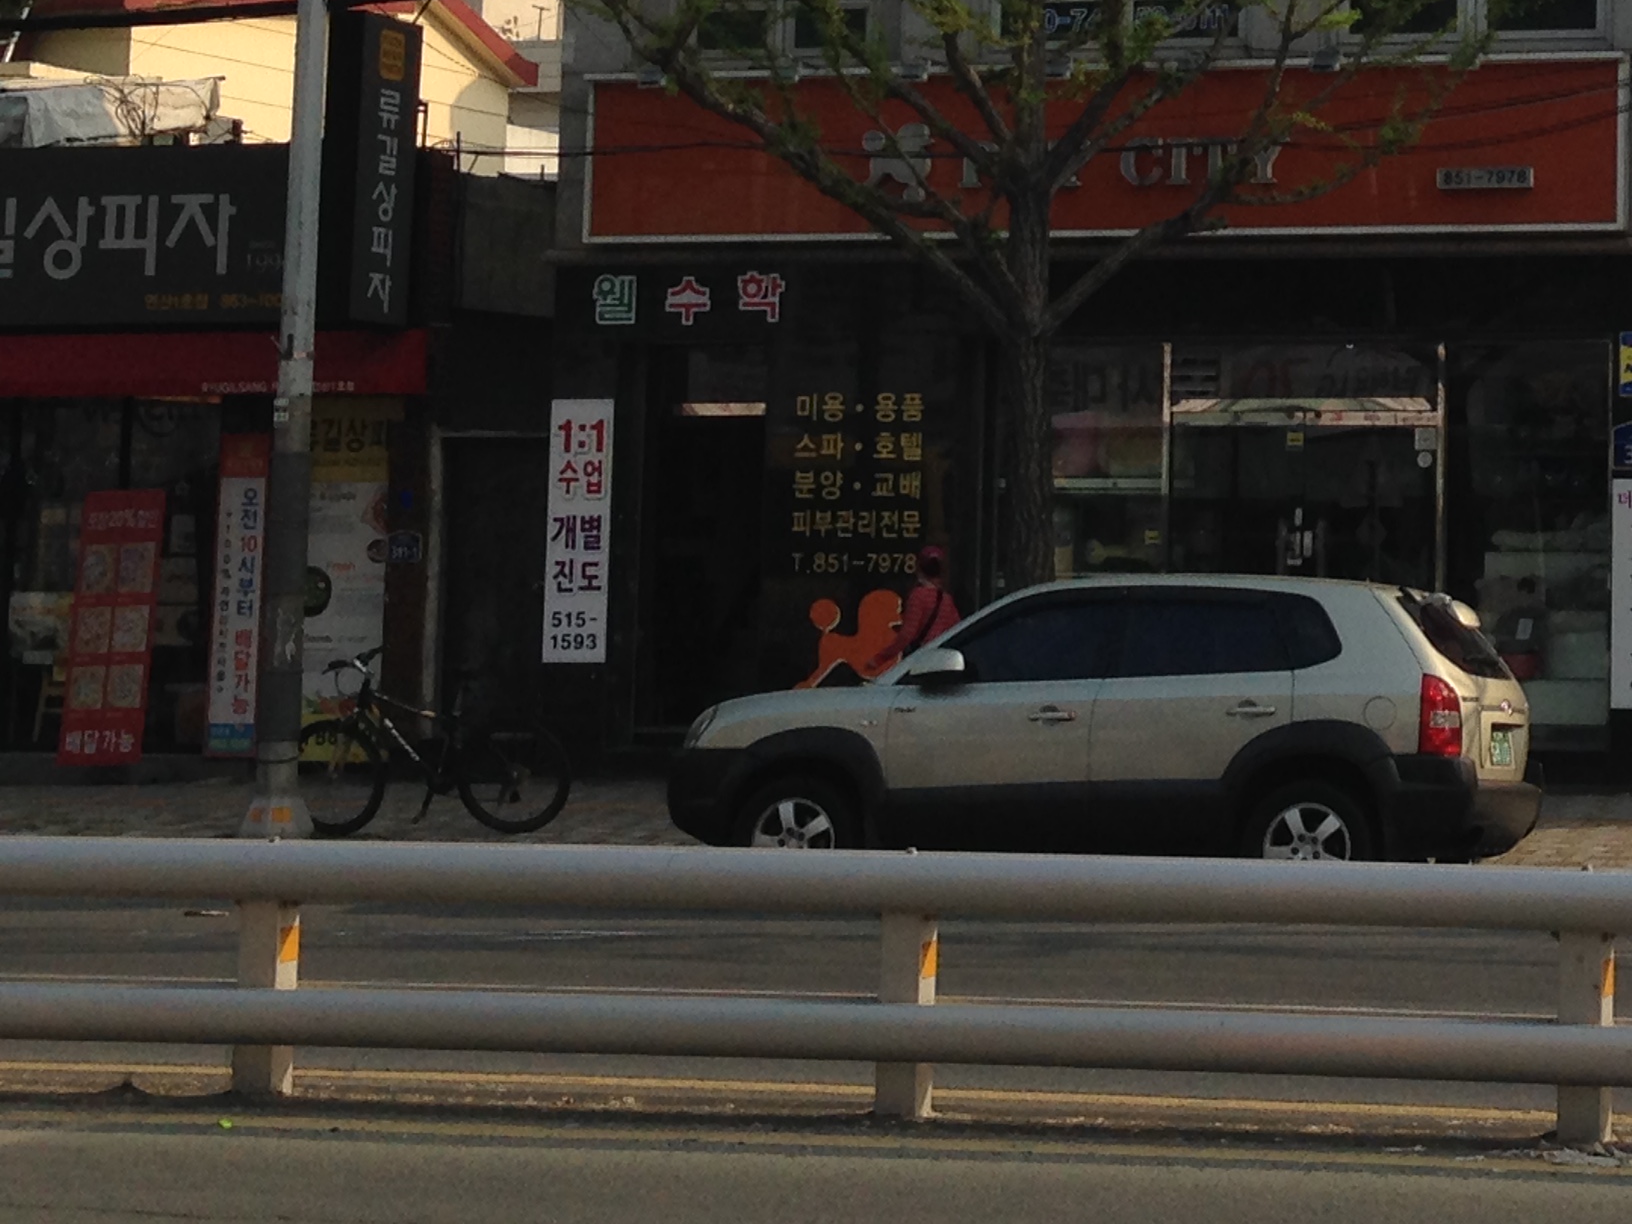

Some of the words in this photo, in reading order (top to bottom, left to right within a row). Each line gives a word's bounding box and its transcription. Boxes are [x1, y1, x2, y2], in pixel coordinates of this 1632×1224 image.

[1119, 136, 1291, 187] CITY
[366, 87, 401, 316] 류길상피자
[795, 391, 847, 423] 미용
[874, 392, 926, 423] 용품
[559, 419, 606, 453] 1:1
[794, 431, 845, 461] 스파
[872, 431, 924, 462] 호텔
[558, 460, 603, 495] 수업
[791, 469, 844, 501] 분양
[870, 469, 922, 500] 교배
[552, 515, 602, 551] 개별
[791, 509, 922, 539] 피부관리전문
[554, 558, 602, 593] 진도
[791, 551, 917, 574] T.851-7978
[551, 611, 598, 628] 515-
[551, 633, 598, 650] 1593
